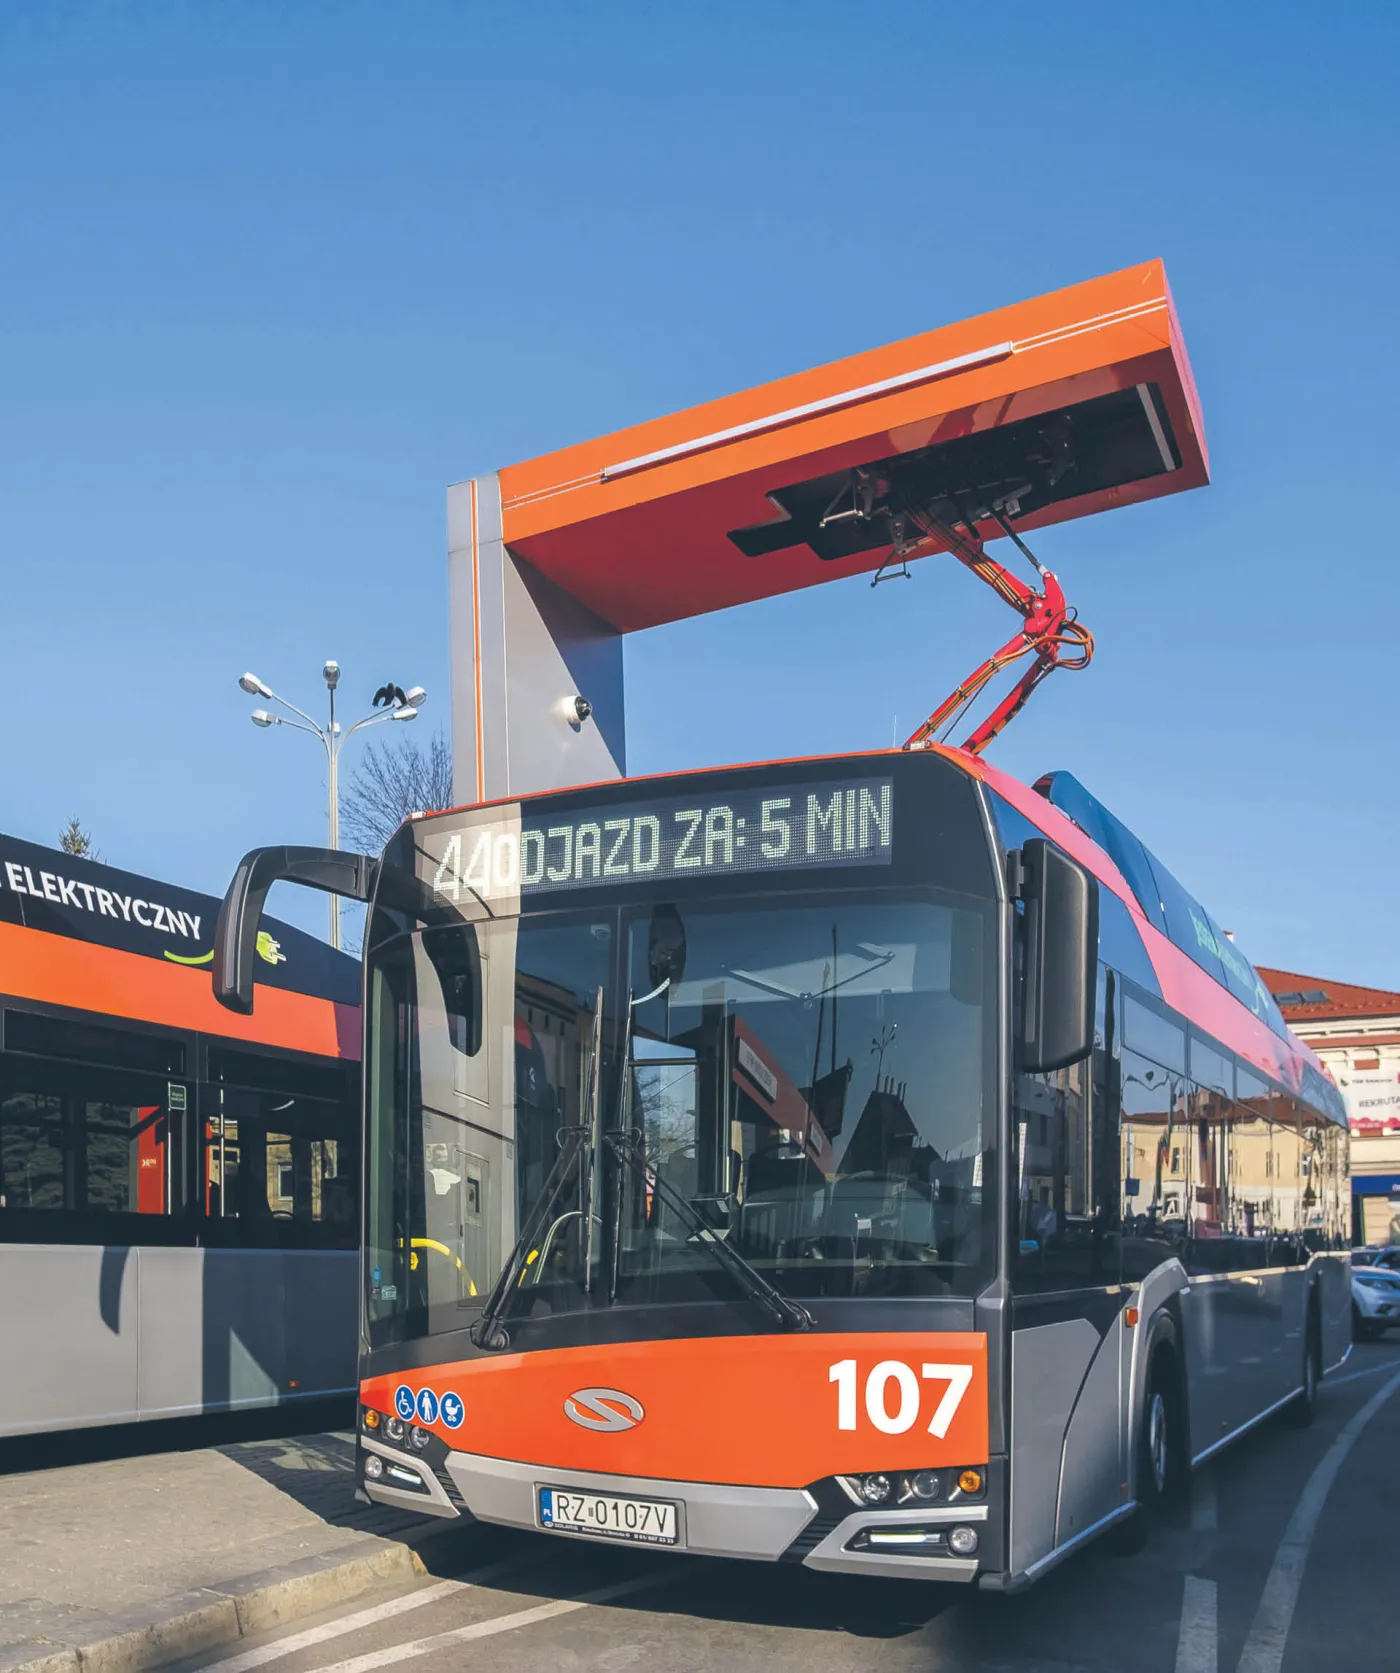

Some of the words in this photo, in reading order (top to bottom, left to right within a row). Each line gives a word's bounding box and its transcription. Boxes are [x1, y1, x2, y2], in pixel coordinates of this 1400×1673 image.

[674, 806, 746, 868] ZA:
[761, 798, 791, 859] 5
[806, 785, 891, 854] MIN
[4, 861, 201, 940] ELEKTRYCZNY
[828, 1359, 973, 1440] 107
[543, 1508, 552, 1517] PL
